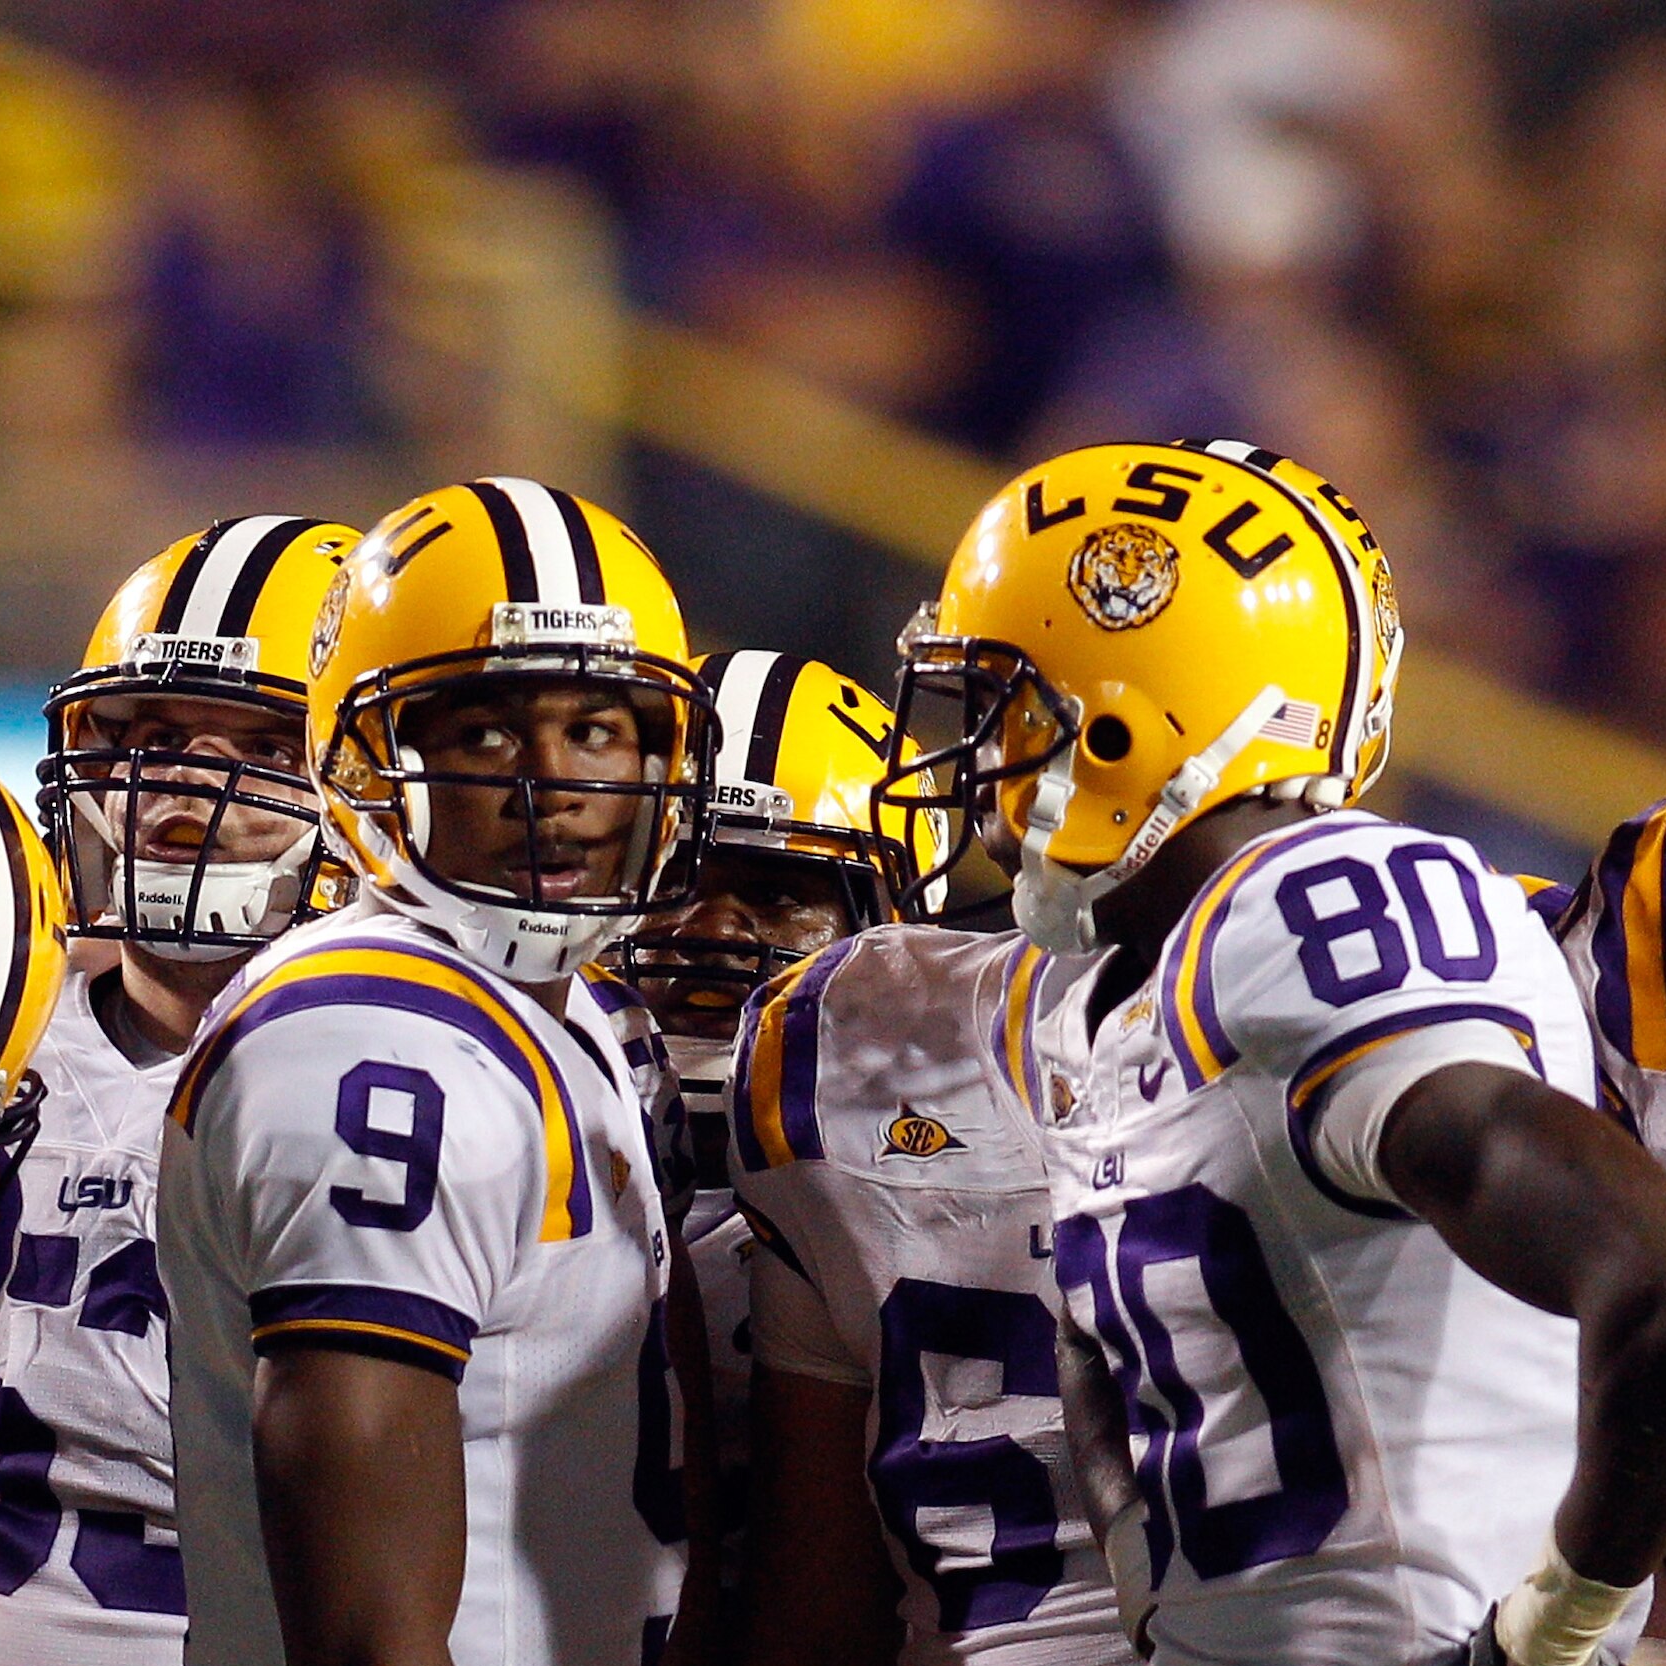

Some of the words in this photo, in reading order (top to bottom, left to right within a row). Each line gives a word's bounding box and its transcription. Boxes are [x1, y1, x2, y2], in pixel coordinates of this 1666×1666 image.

[1027, 463, 1296, 579] LSU
[529, 609, 598, 632] TIGERS
[162, 640, 225, 662] TIGERS
[518, 918, 569, 936] Riddell
[1276, 840, 1498, 1006] 80
[330, 1060, 445, 1233] 9
[901, 1121, 935, 1151] SEC
[57, 1176, 132, 1213] LSU
